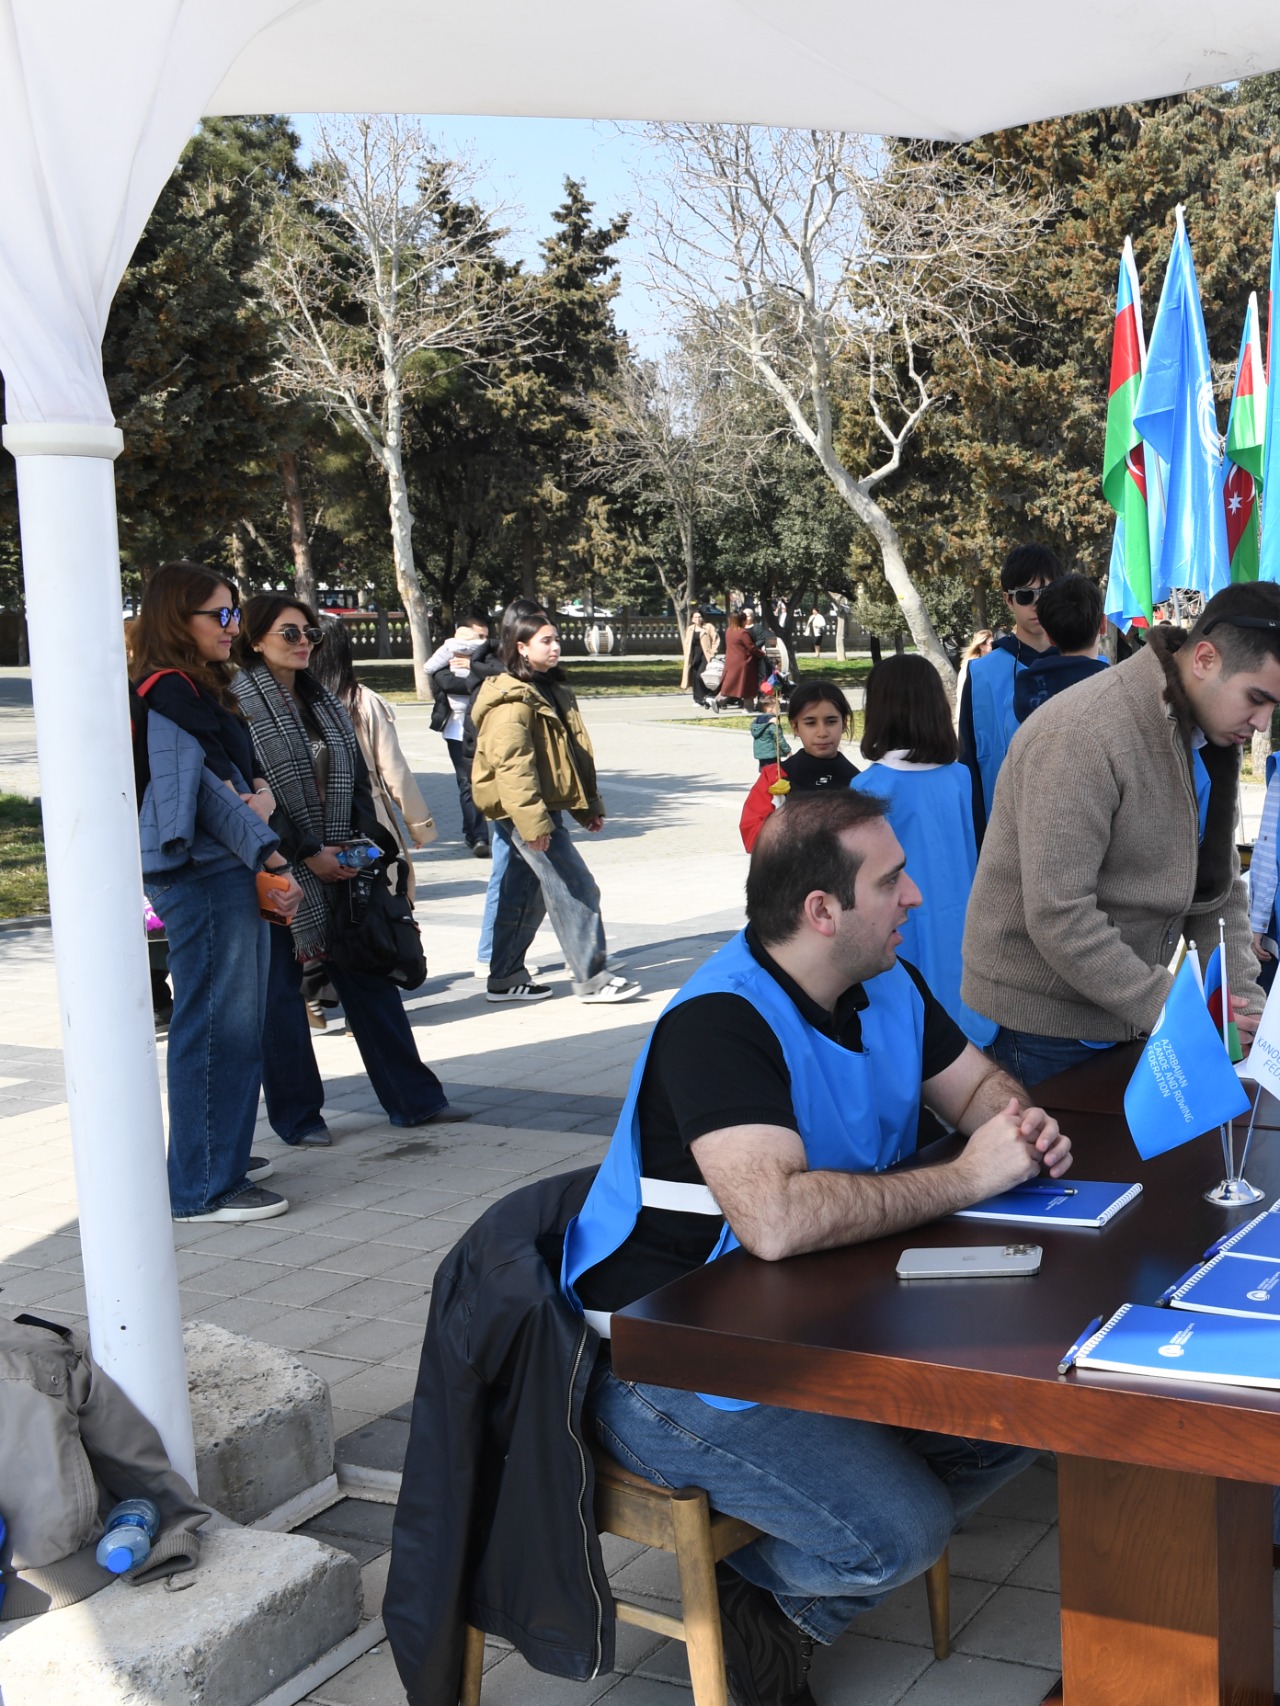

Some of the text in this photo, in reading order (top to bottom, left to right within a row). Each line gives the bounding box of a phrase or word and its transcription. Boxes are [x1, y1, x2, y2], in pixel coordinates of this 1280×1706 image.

[1147, 1045, 1171, 1098] FEDERATION
[1153, 1041, 1194, 1123] CANOE AND ROWING
[1161, 1039, 1189, 1088] AZERBAIJAN
